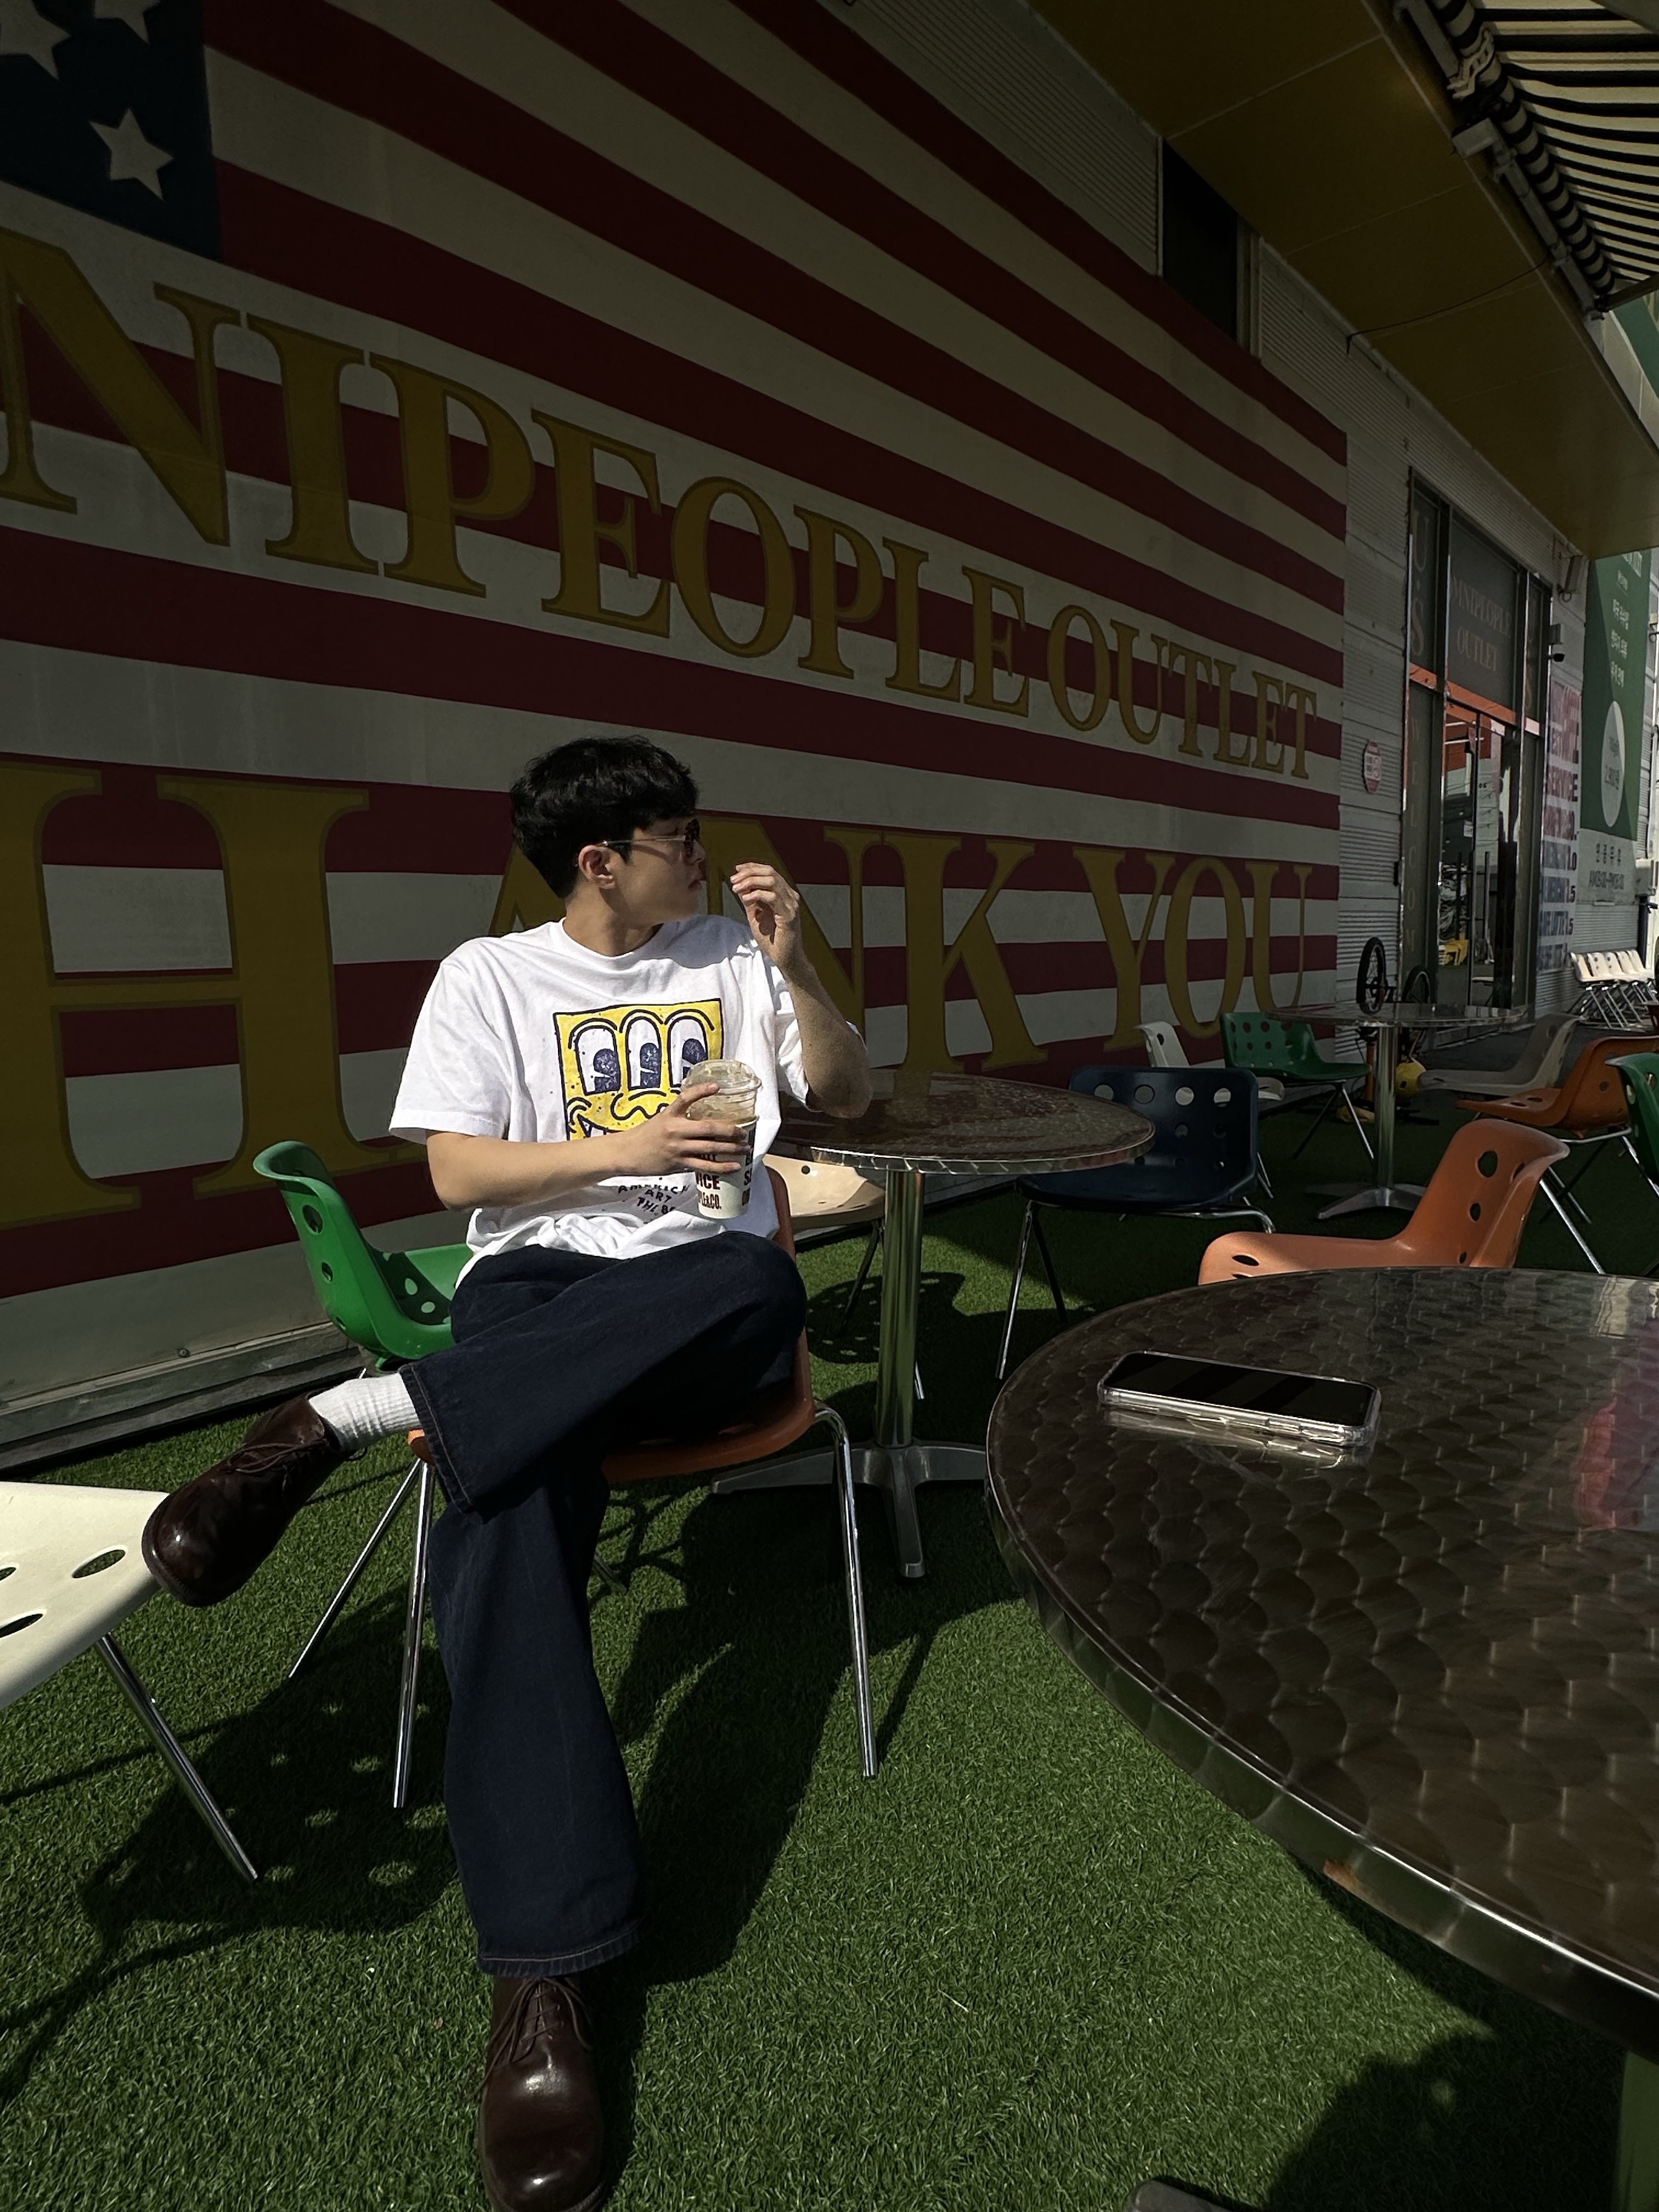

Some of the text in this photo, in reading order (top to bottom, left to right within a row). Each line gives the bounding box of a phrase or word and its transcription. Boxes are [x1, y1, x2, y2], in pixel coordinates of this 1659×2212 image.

[1046, 603, 1318, 780] OUTLET
[1457, 626, 1498, 672] OUTLET
[0, 767, 1049, 1230] HNK
[1071, 845, 1313, 1052] YOU
[644, 1189, 672, 1204] ART
